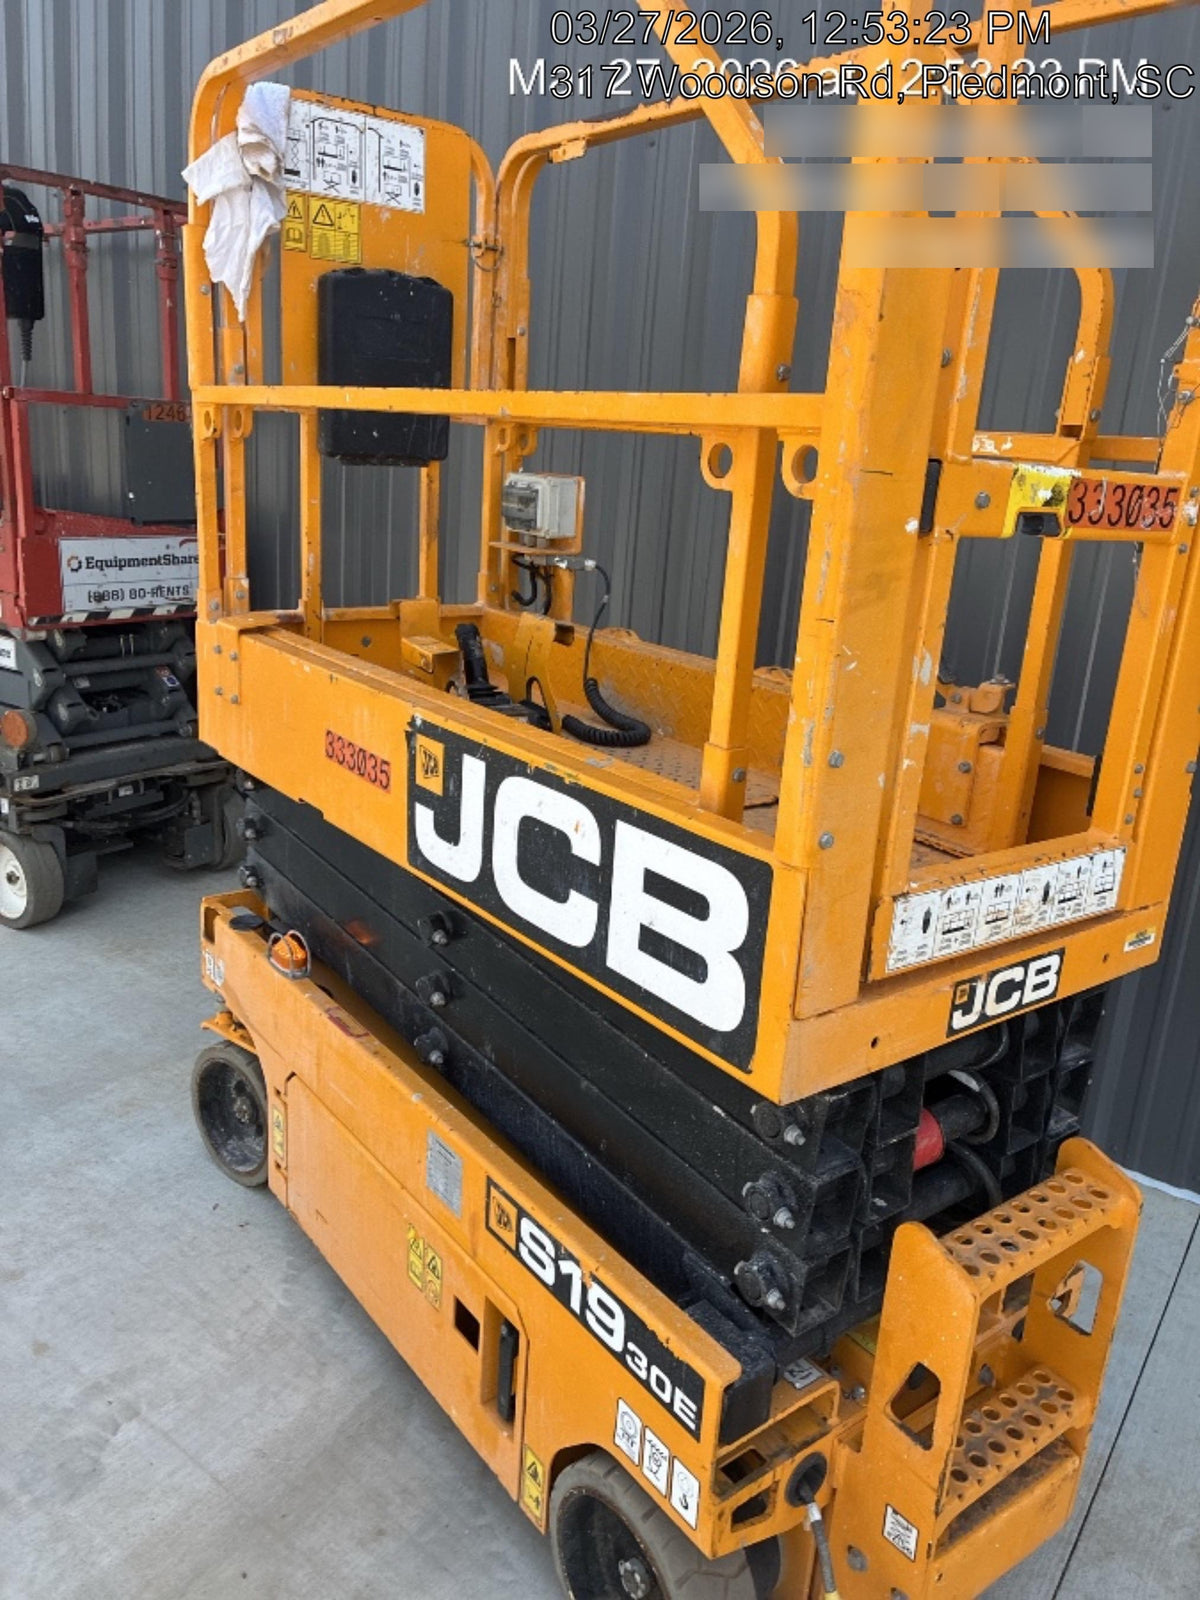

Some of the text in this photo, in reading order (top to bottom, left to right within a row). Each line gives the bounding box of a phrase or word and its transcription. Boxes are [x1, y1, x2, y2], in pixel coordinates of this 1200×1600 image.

[1068, 481, 1179, 528] 333035
[325, 729, 391, 790] 333035
[415, 753, 749, 1032] JCB
[952, 954, 1061, 1030] JCB
